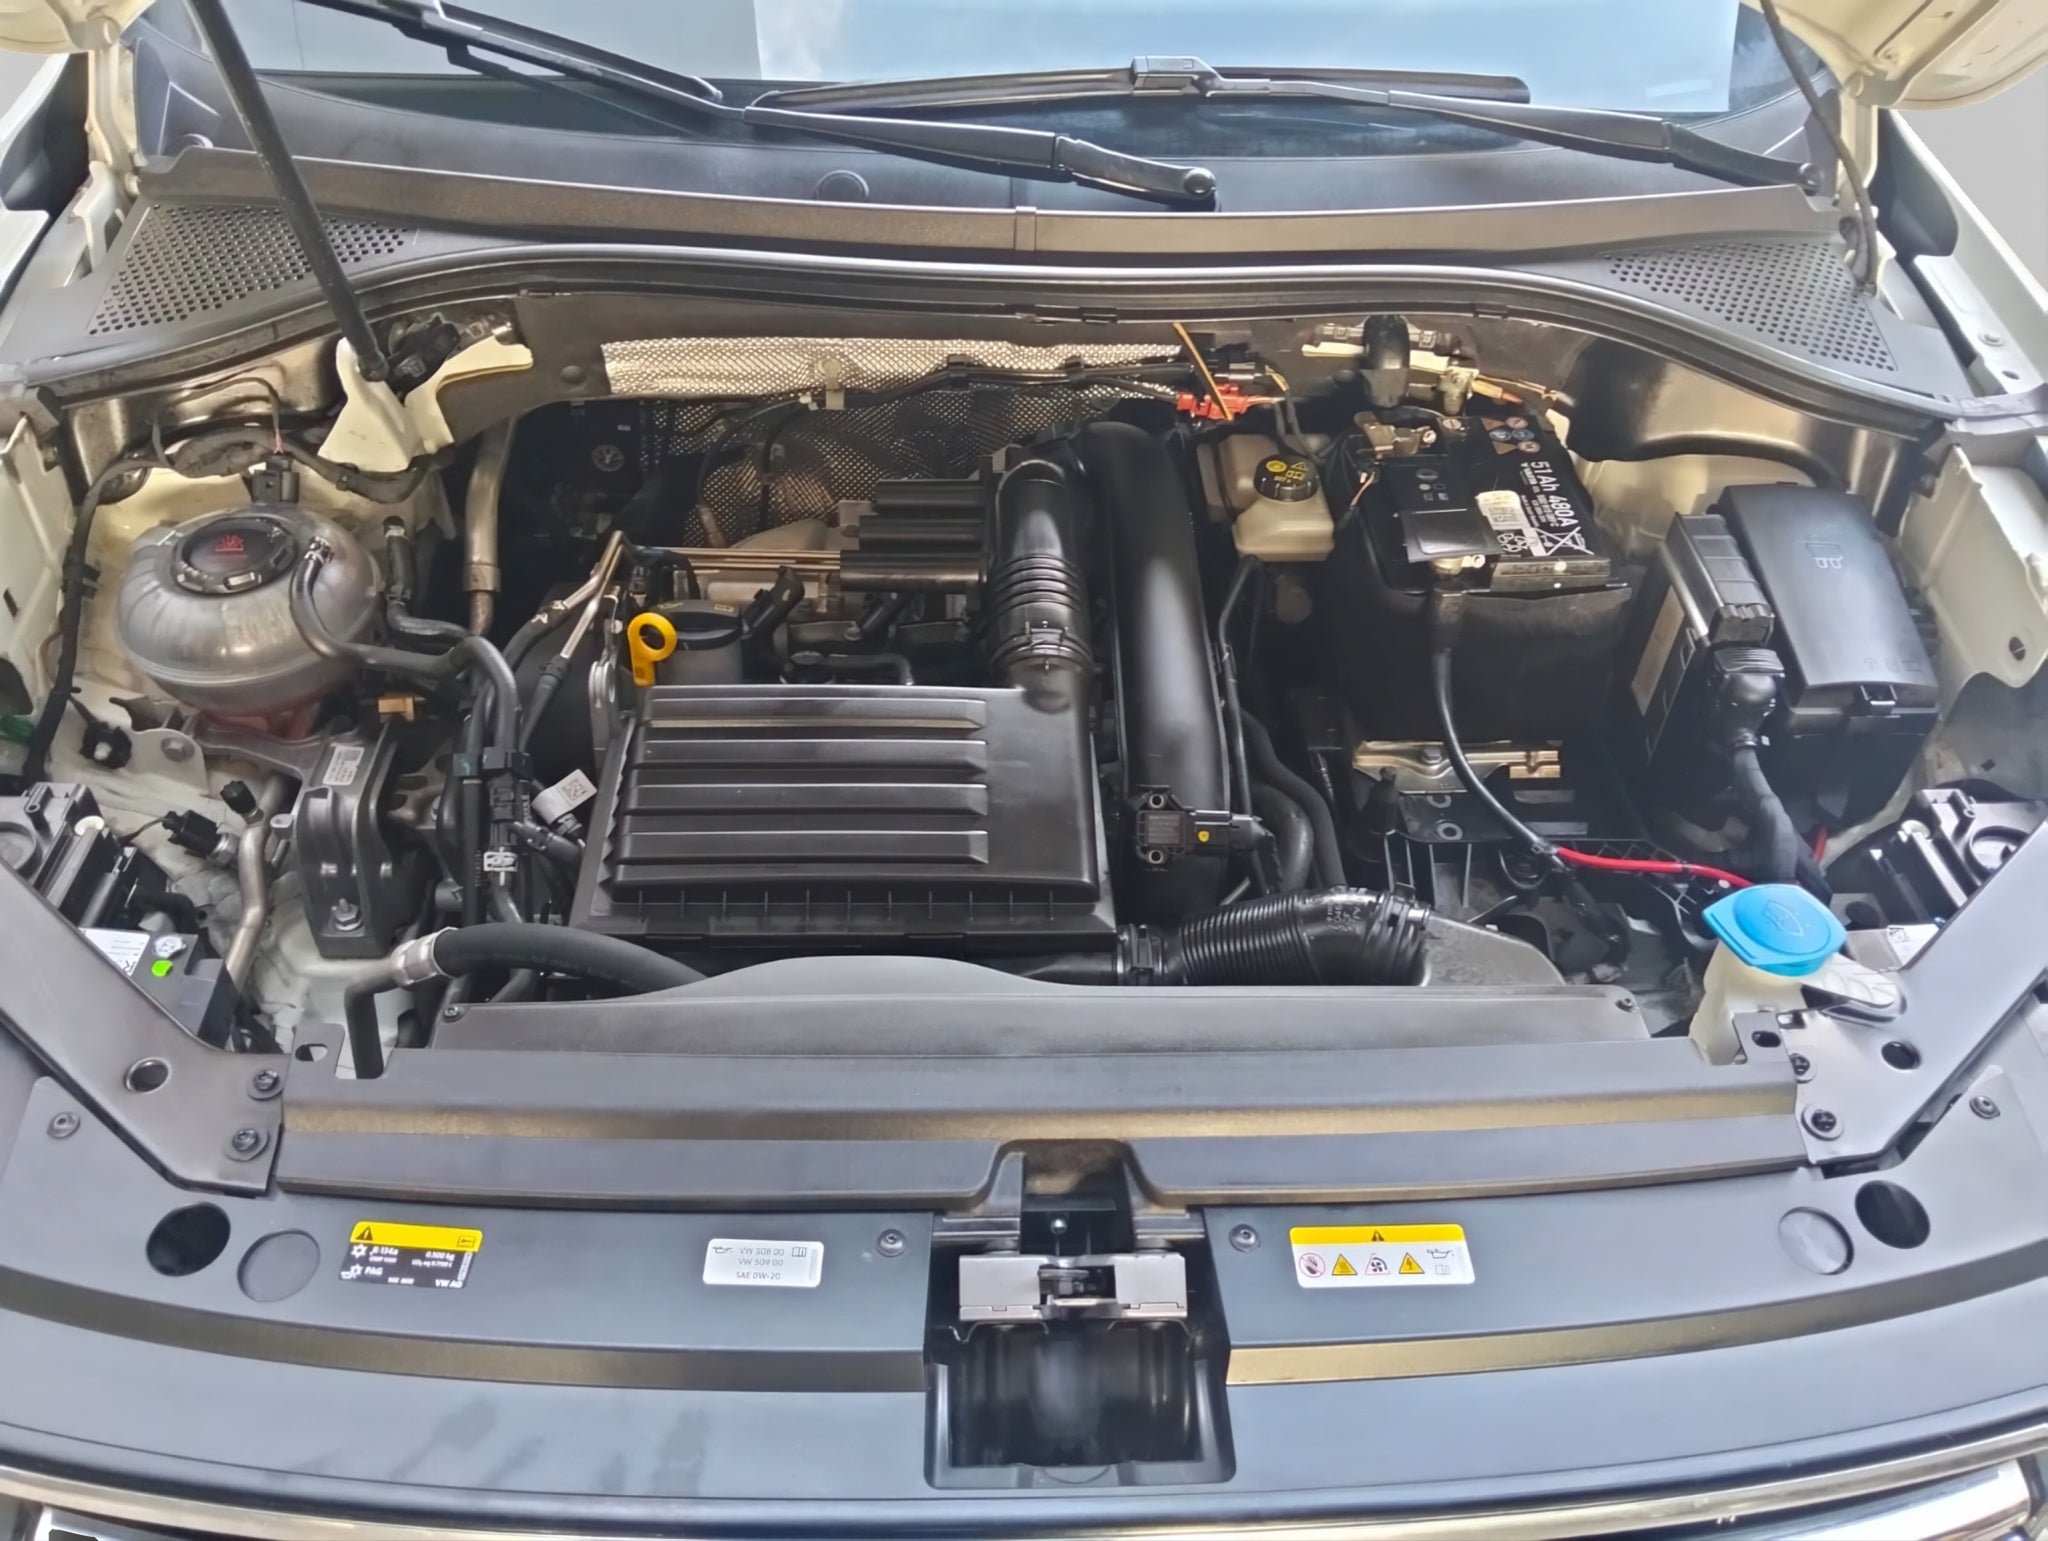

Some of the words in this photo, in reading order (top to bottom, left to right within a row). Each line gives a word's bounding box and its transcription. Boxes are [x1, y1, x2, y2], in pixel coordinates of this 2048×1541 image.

[1548, 495, 1579, 527] 480A
[739, 1247, 753, 1256] VW
[755, 1247, 772, 1257] 508
[773, 1248, 785, 1257] 00
[738, 1258, 753, 1267] VW
[754, 1259, 770, 1267] 509
[772, 1259, 783, 1267] 00
[364, 1265, 384, 1276] PAG
[735, 1271, 750, 1280] SAE
[752, 1271, 781, 1281] 0W-20
[435, 1279, 451, 1288] VW
